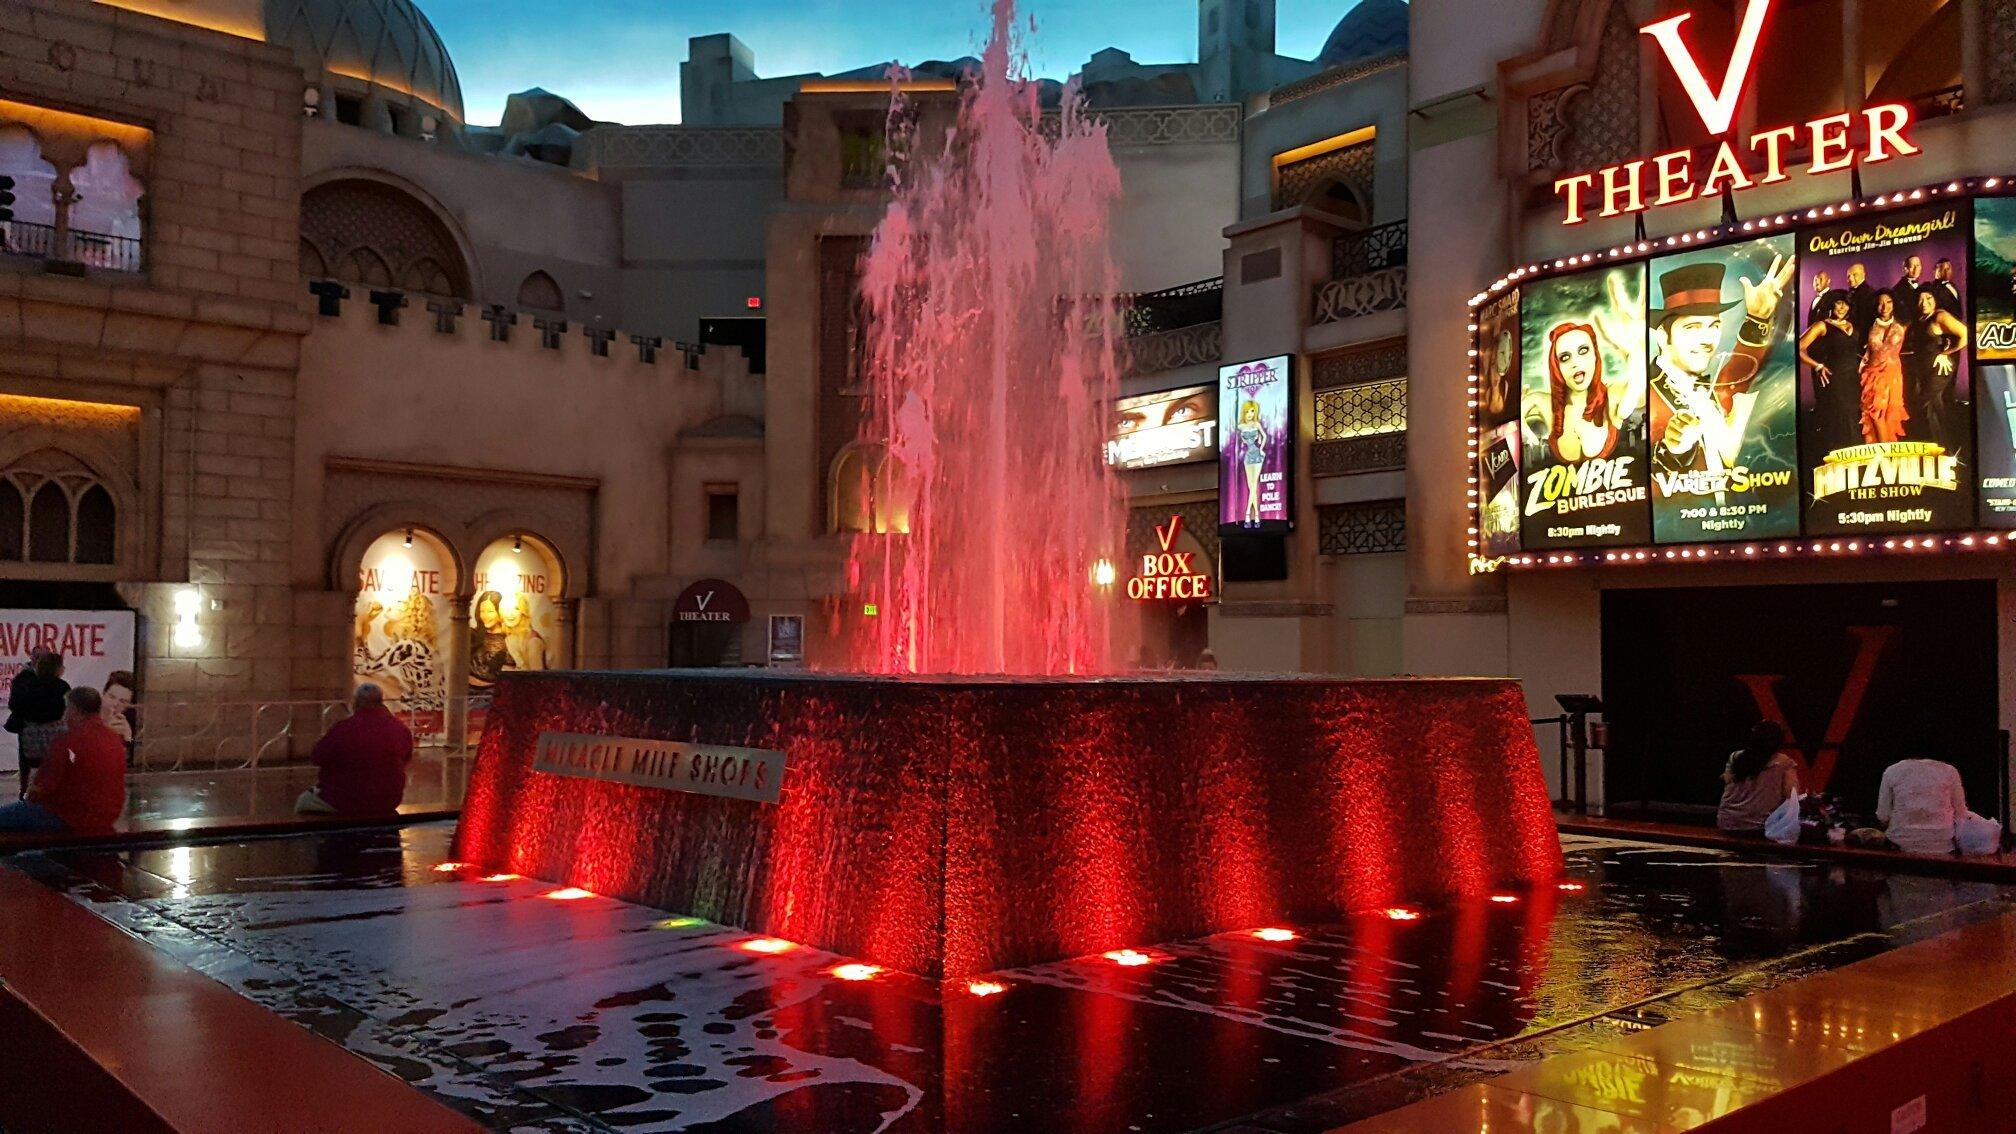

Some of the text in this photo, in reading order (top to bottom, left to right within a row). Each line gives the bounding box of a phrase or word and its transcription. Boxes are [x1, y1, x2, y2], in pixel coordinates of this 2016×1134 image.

[1639, 0, 1771, 135] V
[1554, 103, 1921, 225] THEATER
[1809, 211, 1956, 253] Our Own Dreamgirl!
[1829, 245, 1861, 256] Starring
[1977, 322, 2016, 349] AU
[1227, 367, 1278, 390] STRIPPER
[1836, 443, 1929, 461] MOTOWN REVUE
[1260, 472, 1282, 482] LEARN
[1525, 456, 1635, 517] ZOMBIE
[1656, 466, 1791, 498] VARIETY SHOW
[1814, 455, 1957, 500] HITZVILLE
[1557, 487, 1646, 515] BURLESQUE
[1848, 485, 1924, 500] THE SHOW
[1709, 507, 1718, 517] &
[1719, 506, 1747, 516] 8:30
[1748, 504, 1768, 514] PM
[1838, 508, 1933, 525] 5:30pm Nightly
[1155, 515, 1183, 551] V
[1547, 524, 1621, 539] 8:30pm Nightly
[1701, 519, 1746, 531] Nightly
[1143, 552, 1193, 577] BOX
[1127, 575, 1210, 599] OFFICE
[696, 591, 715, 611] V
[679, 611, 731, 622] THEATER
[1734, 624, 1896, 796] V
[545, 740, 769, 791] MIRACLE MILE SHOPS
